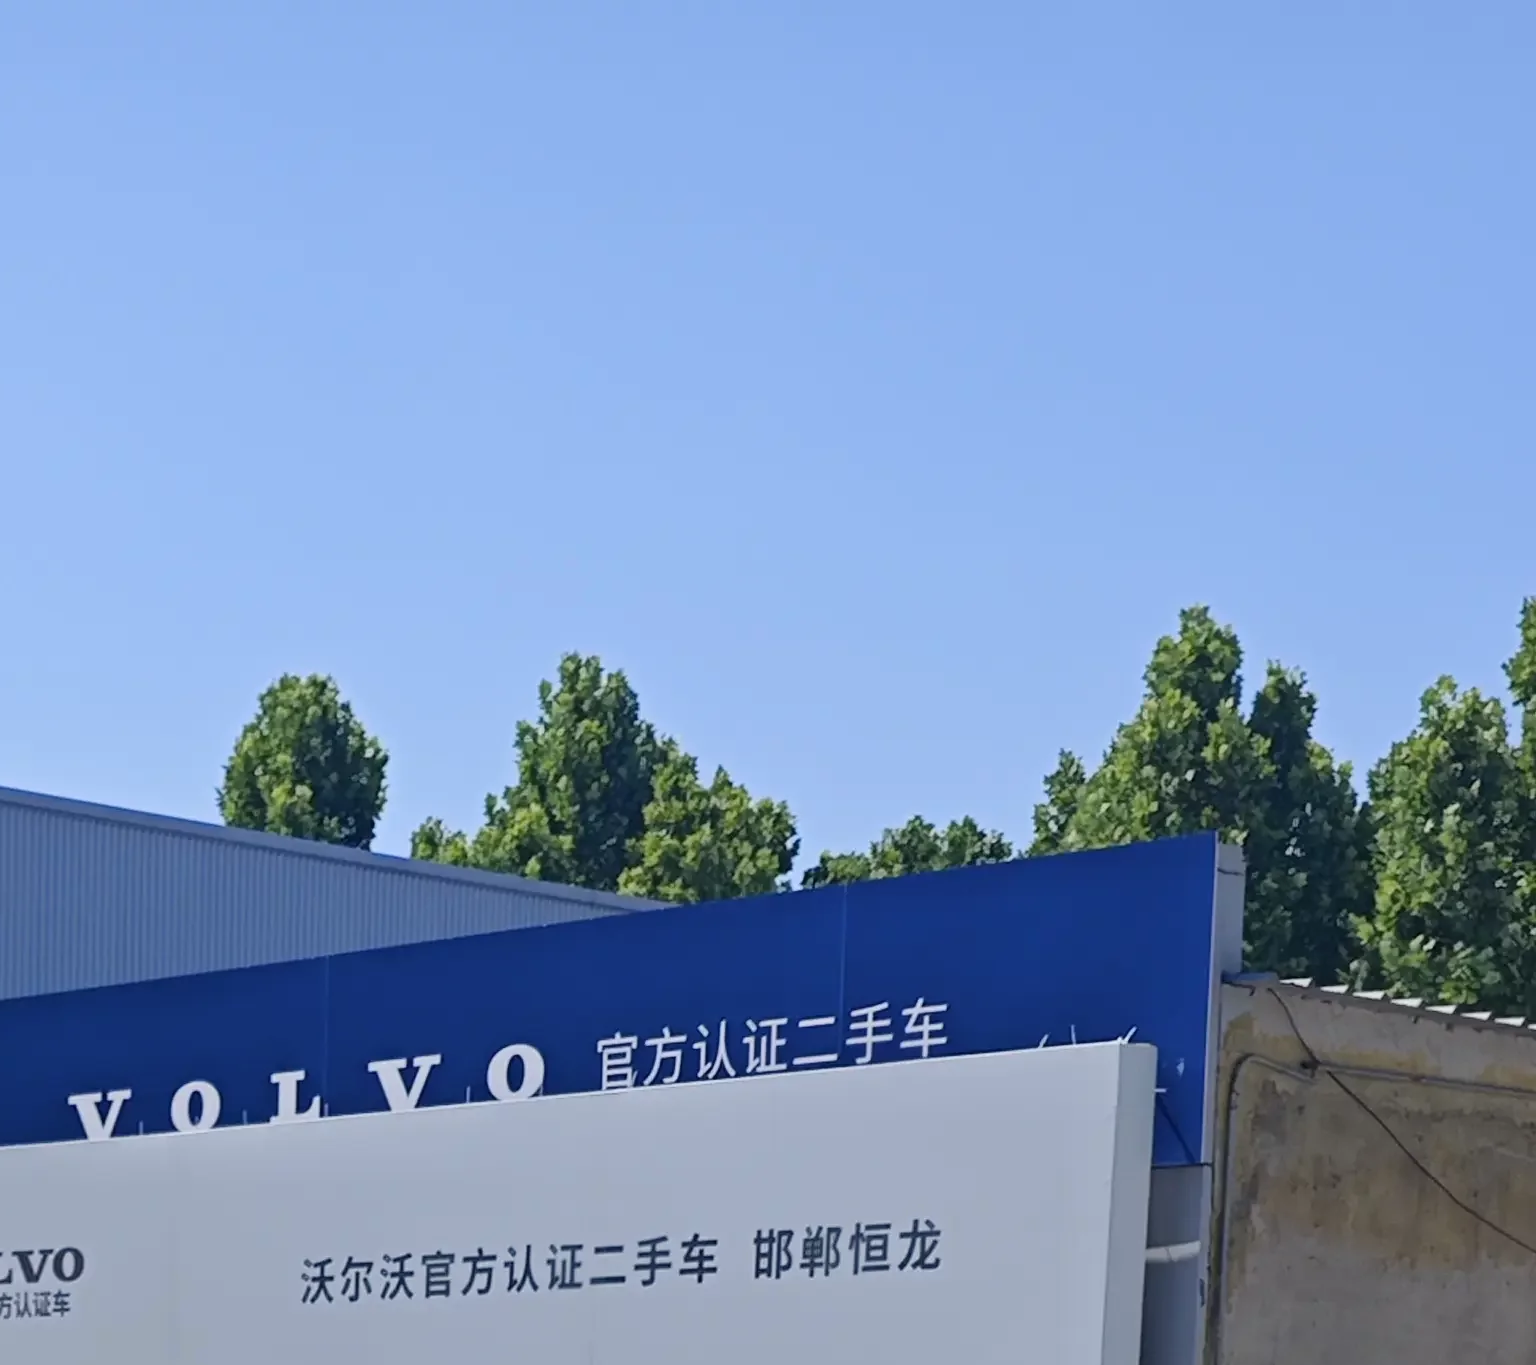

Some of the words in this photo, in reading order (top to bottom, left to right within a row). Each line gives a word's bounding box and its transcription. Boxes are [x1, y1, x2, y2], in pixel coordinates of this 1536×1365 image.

[596, 996, 949, 1091] 官方认证二手车
[67, 1043, 545, 1141] VOLVO
[300, 1233, 720, 1304] 沃尔沃官方认证二手车
[752, 1218, 942, 1280] 邯郸恒龙
